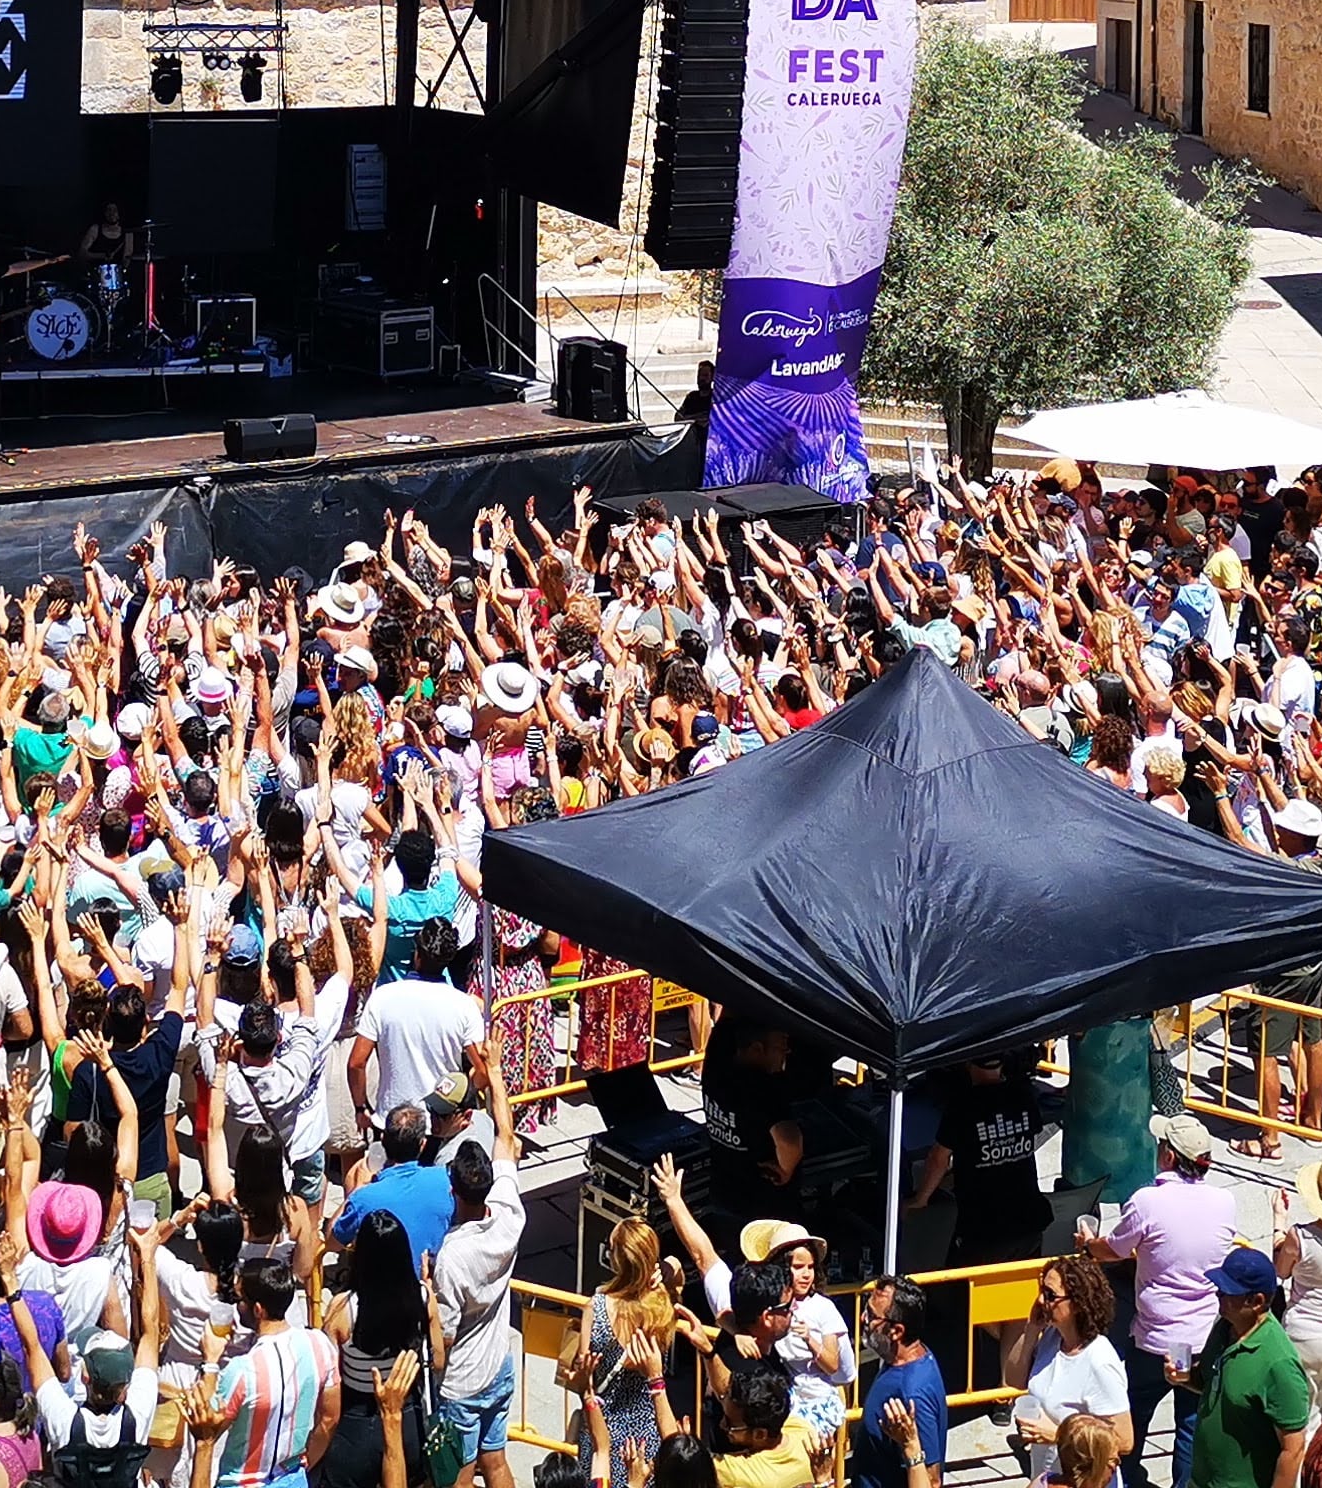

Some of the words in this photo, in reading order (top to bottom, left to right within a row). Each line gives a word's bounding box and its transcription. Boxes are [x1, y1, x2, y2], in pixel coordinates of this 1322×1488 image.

[789, 49, 884, 83] FEST
[787, 92, 882, 106] CALERUEGA
[742, 309, 823, 348] Caleruega
[707, 1123, 741, 1145] onido
[981, 1136, 1031, 1161] Sonido
